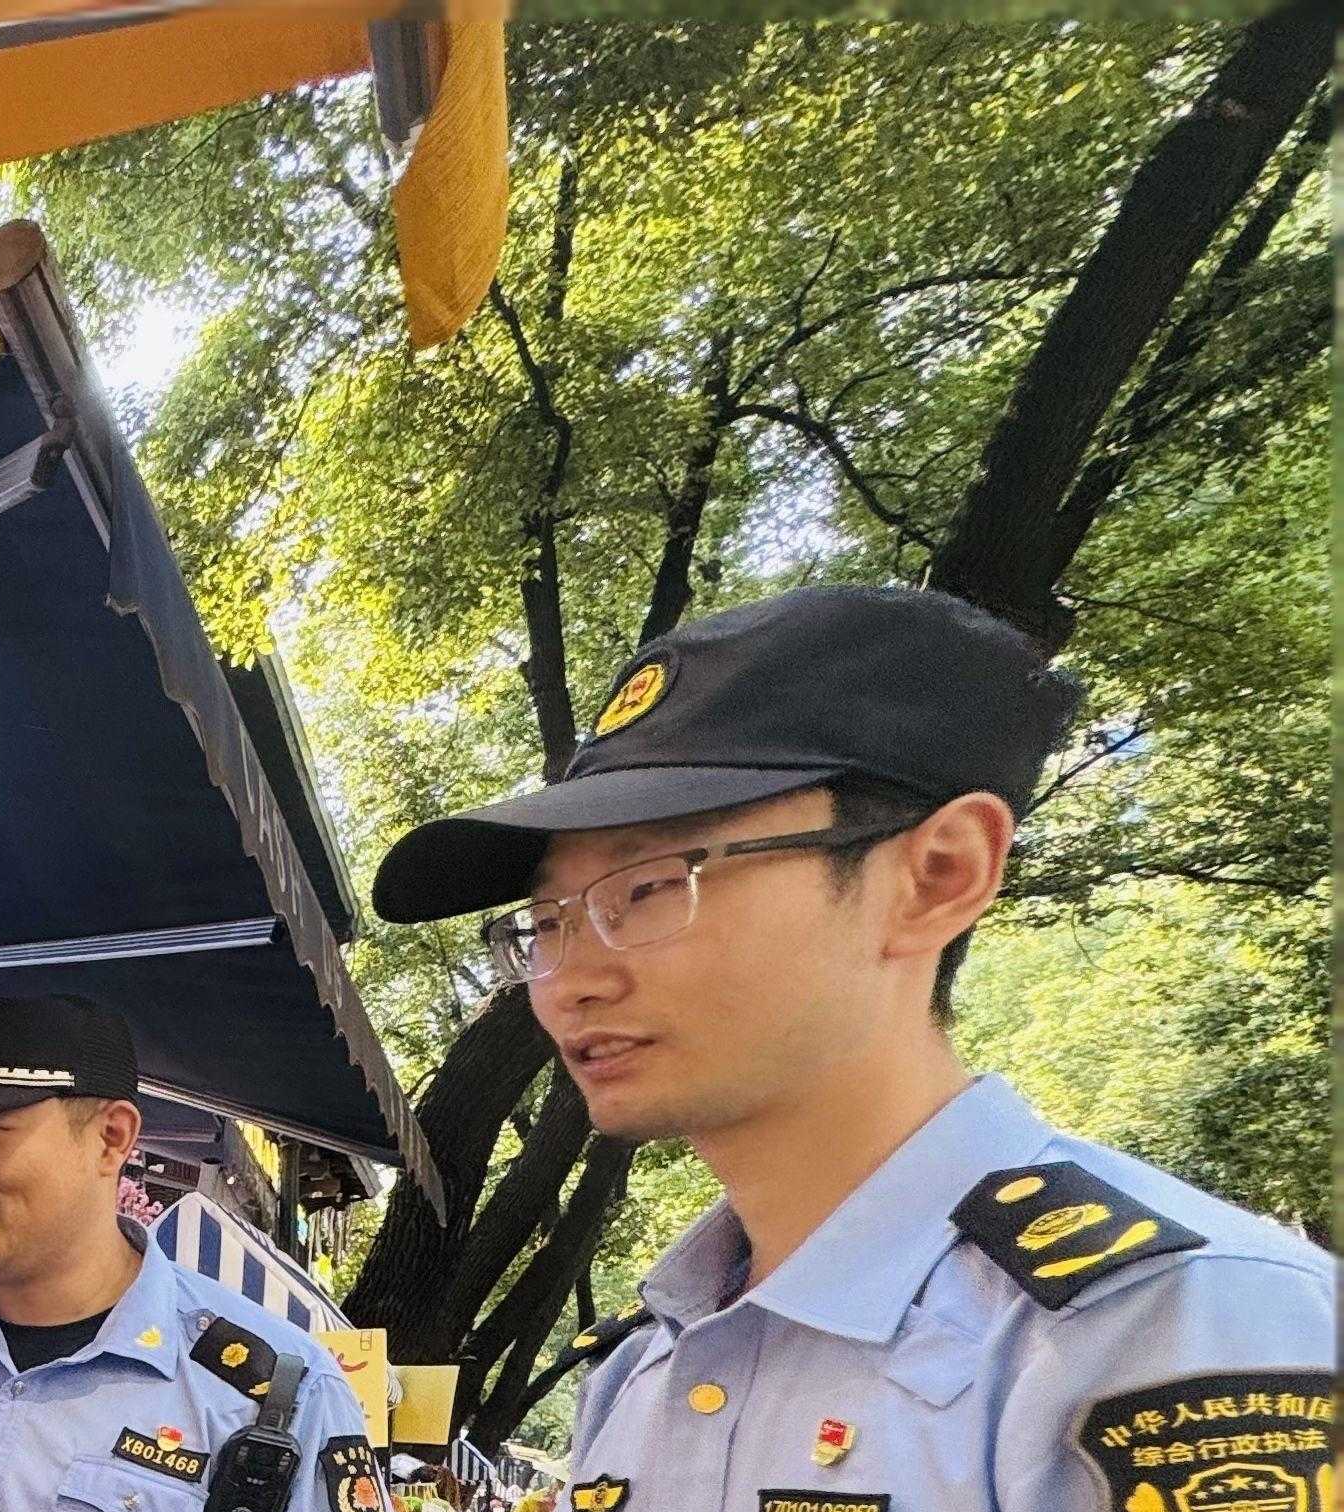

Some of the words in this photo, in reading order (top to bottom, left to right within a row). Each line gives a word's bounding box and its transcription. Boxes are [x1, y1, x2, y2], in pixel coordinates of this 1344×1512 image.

[120, 1435, 200, 1475] XB01468
[1131, 1427, 1328, 1467] 综合行政执法
